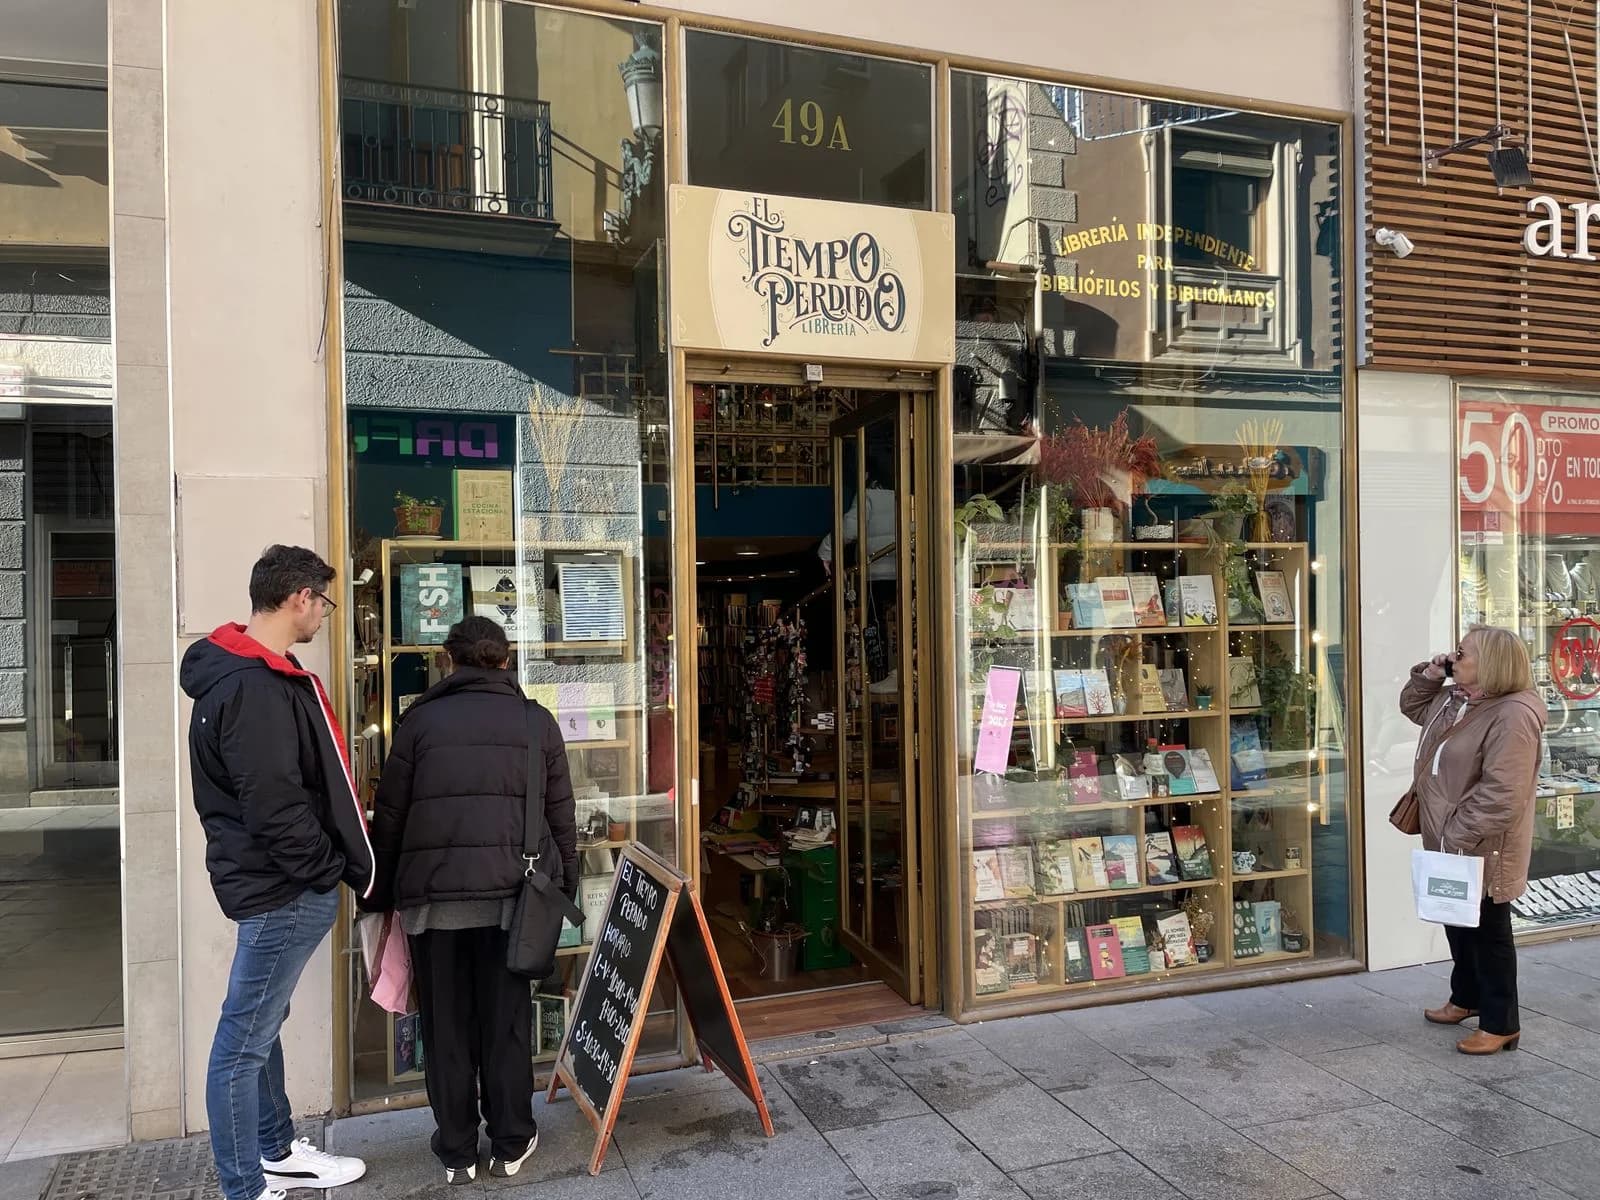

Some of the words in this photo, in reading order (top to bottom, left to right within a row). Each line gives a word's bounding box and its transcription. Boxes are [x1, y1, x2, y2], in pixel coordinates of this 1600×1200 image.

[772, 98, 852, 151] 49A
[752, 197, 780, 224] EL
[728, 214, 880, 284] TIEMPO
[1056, 216, 1129, 257] LIBRERÍA
[1137, 223, 1255, 272] INDEPENDIENTE
[1137, 254, 1173, 271] PARA
[1040, 269, 1141, 298] BIBLIÓFILOS
[1149, 283, 1160, 300] Y
[753, 272, 906, 347] PERDIDO
[1459, 411, 1535, 504] 50
[1536, 437, 1562, 456] DTO
[1566, 456, 1581, 478] EN
